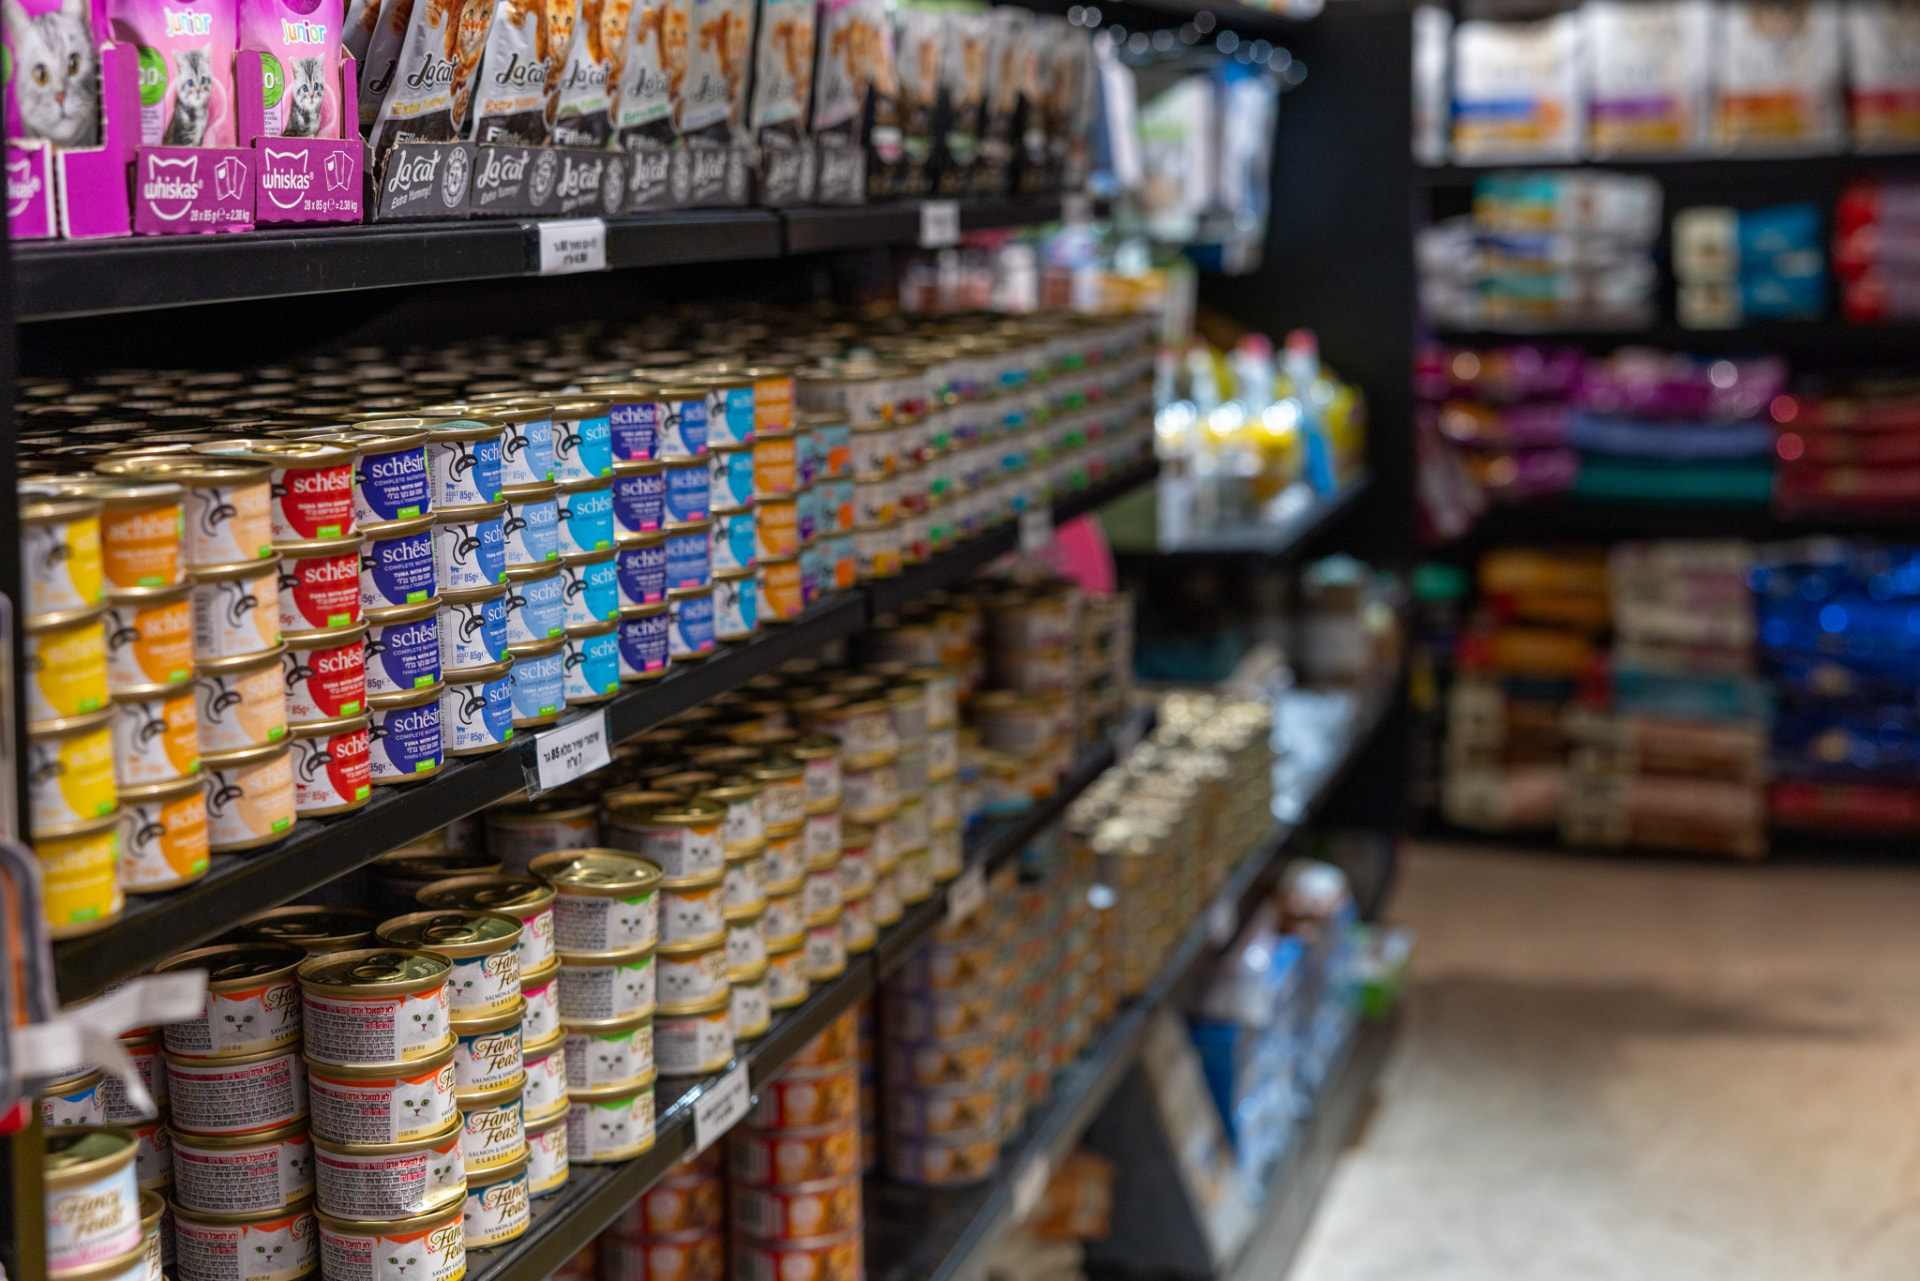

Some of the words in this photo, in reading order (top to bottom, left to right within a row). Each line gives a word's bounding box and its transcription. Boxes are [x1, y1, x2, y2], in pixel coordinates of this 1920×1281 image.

[164, 8, 211, 37] Junior
[281, 18, 326, 43] Junior
[392, 101, 420, 116] Extra
[263, 167, 309, 190] whiskas
[144, 175, 199, 200] whiskas
[351, 199, 358, 212] kg
[391, 194, 407, 210] Extra
[459, 490, 472, 501] 85g
[464, 573, 477, 584] 85g
[392, 647, 423, 656] COMPLETE
[469, 650, 482, 661] 85g
[367, 679, 382, 689] 85g
[395, 731, 425, 741] COMPLETE
[470, 732, 483, 743] 85g
[551, 747, 561, 761] 85
[485, 990, 507, 1002] SALMON
[472, 1072, 496, 1084] SALMON
[479, 1078, 510, 1090] CLASSIC
[468, 1147, 494, 1158] SALMON
[476, 1151, 509, 1164] CLASSIC
[484, 1223, 508, 1235] SALMON
